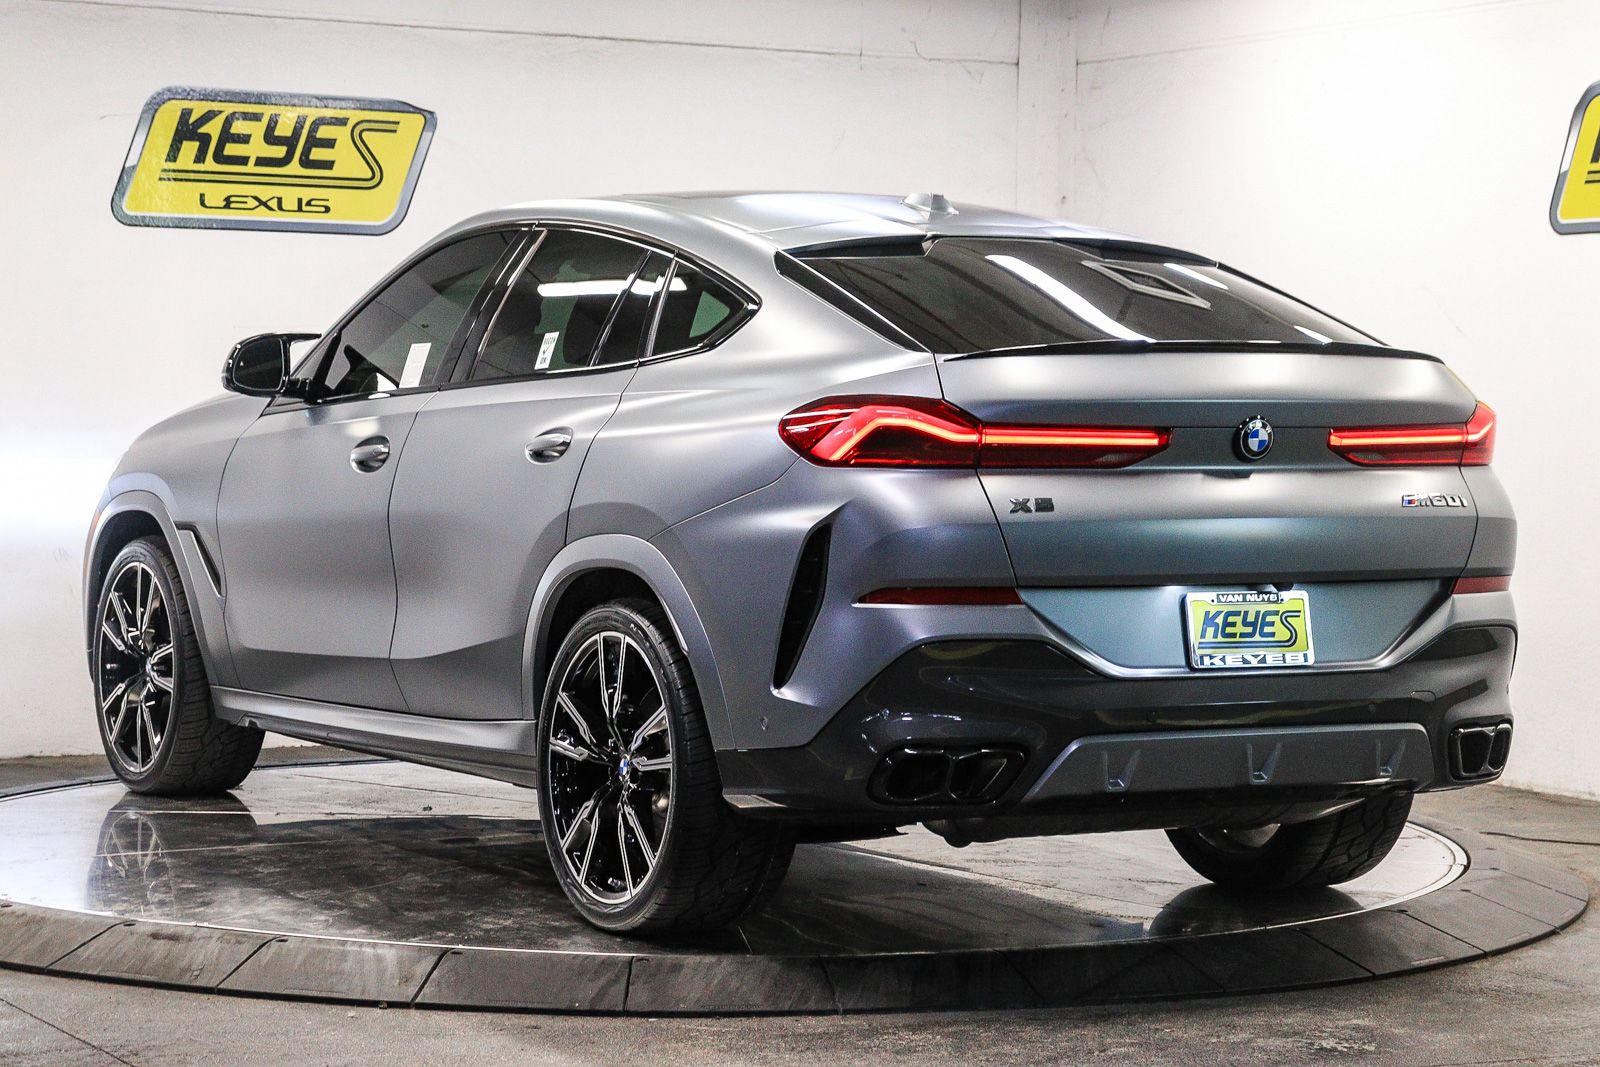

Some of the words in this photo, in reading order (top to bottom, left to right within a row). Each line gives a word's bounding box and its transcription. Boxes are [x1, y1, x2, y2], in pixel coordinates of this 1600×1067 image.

[164, 108, 400, 190] KEYES
[200, 192, 331, 214] LEXUS
[1219, 594, 1243, 603] VAN
[1199, 609, 1302, 648] KEYES
